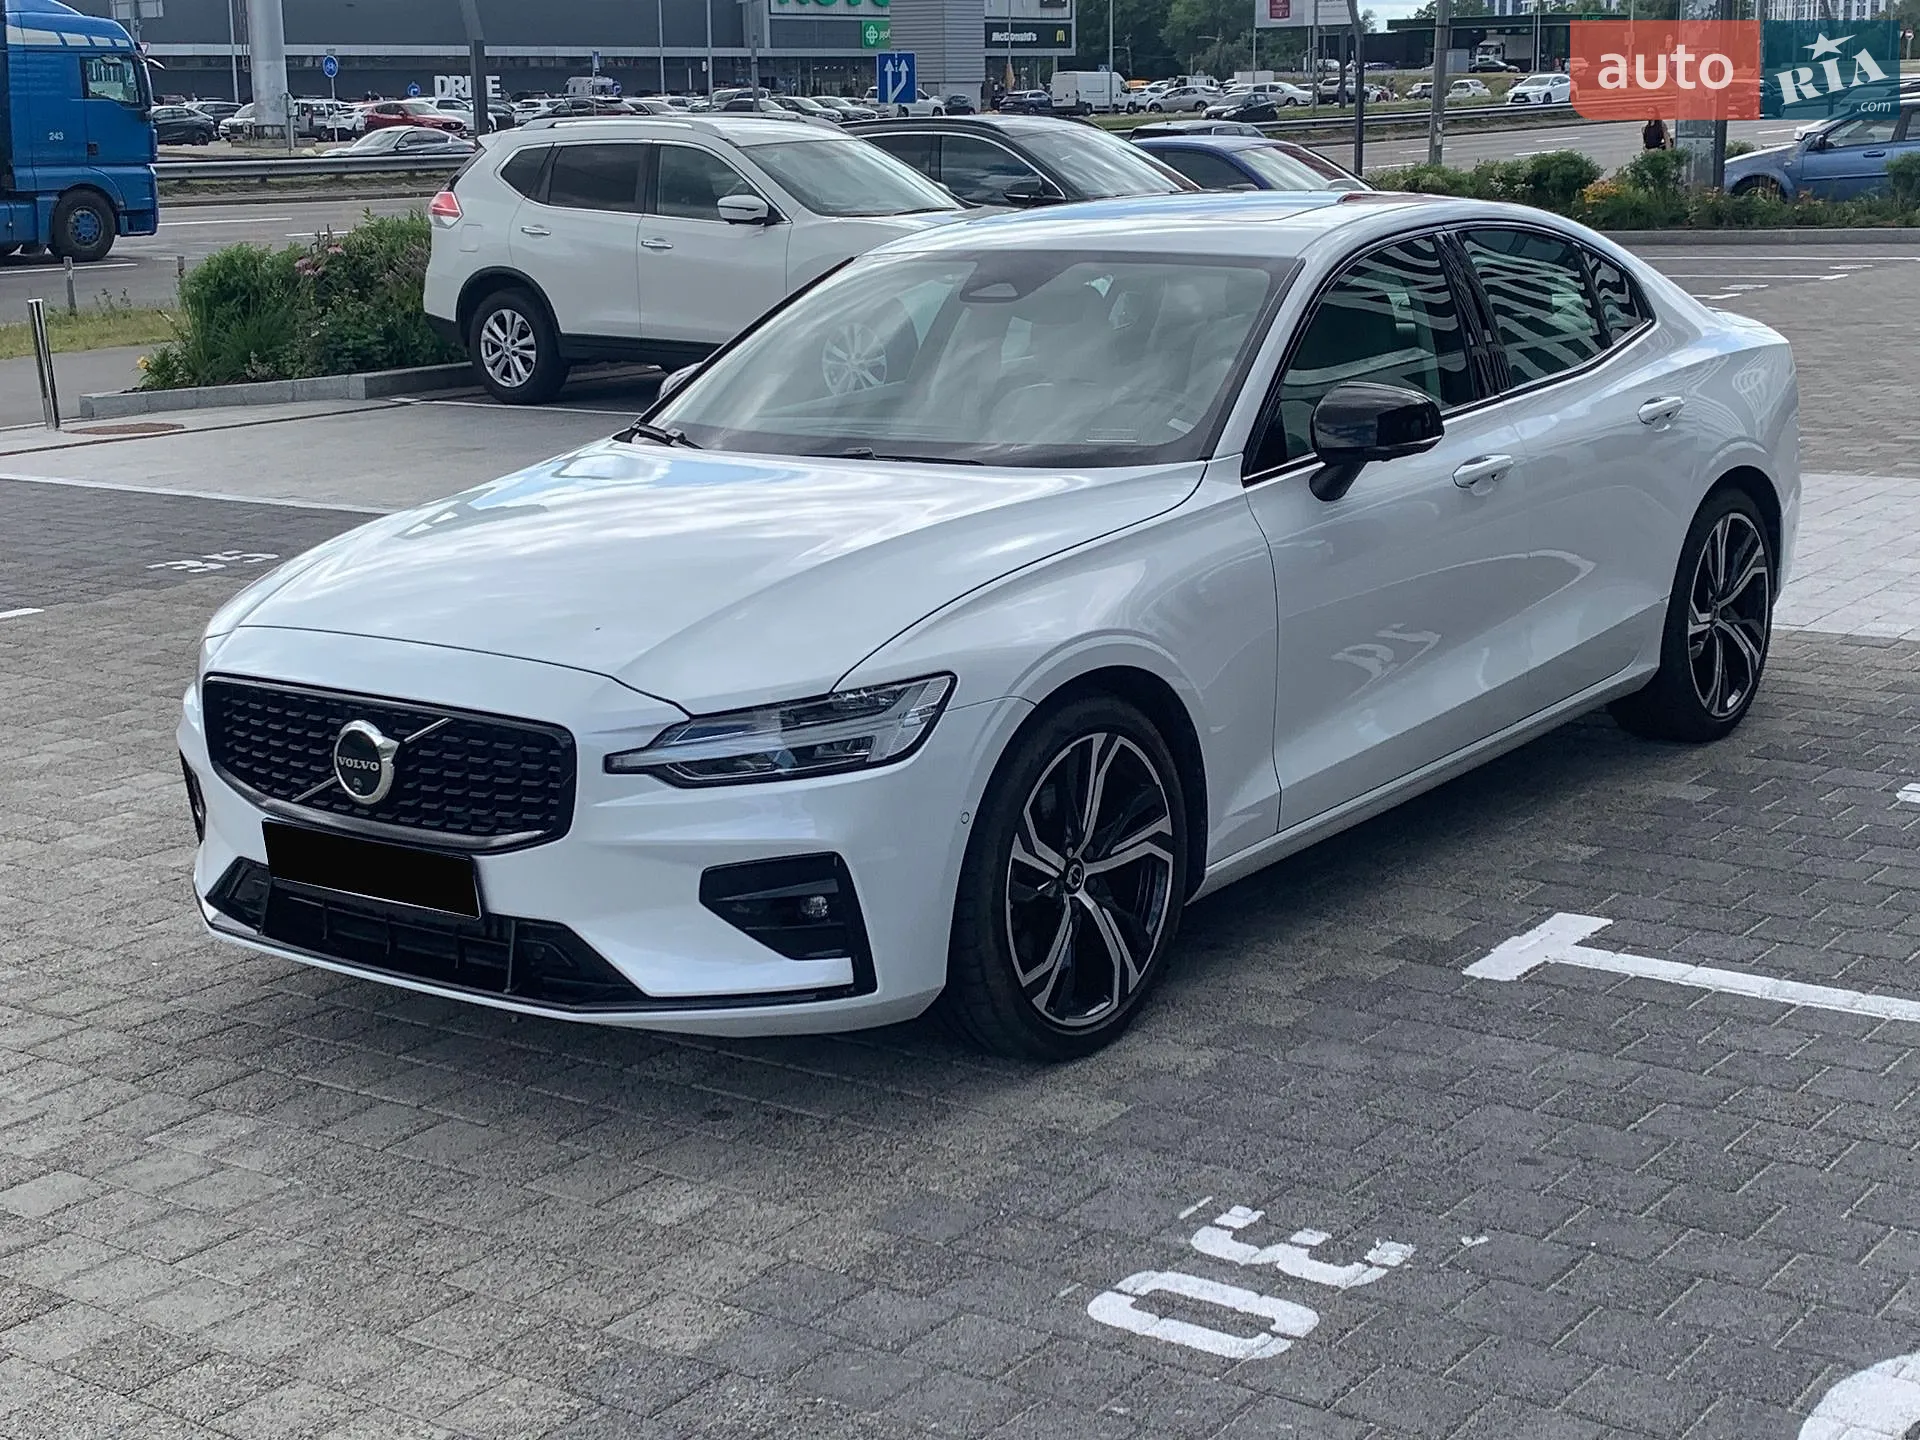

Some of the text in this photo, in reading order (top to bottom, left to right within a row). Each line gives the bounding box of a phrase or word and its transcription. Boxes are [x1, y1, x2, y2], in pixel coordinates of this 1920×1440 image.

[991, 31, 1038, 42] McDonald's
[434, 75, 502, 98] DRIE
[48, 131, 64, 141] 243
[337, 756, 380, 772] VOLVO
